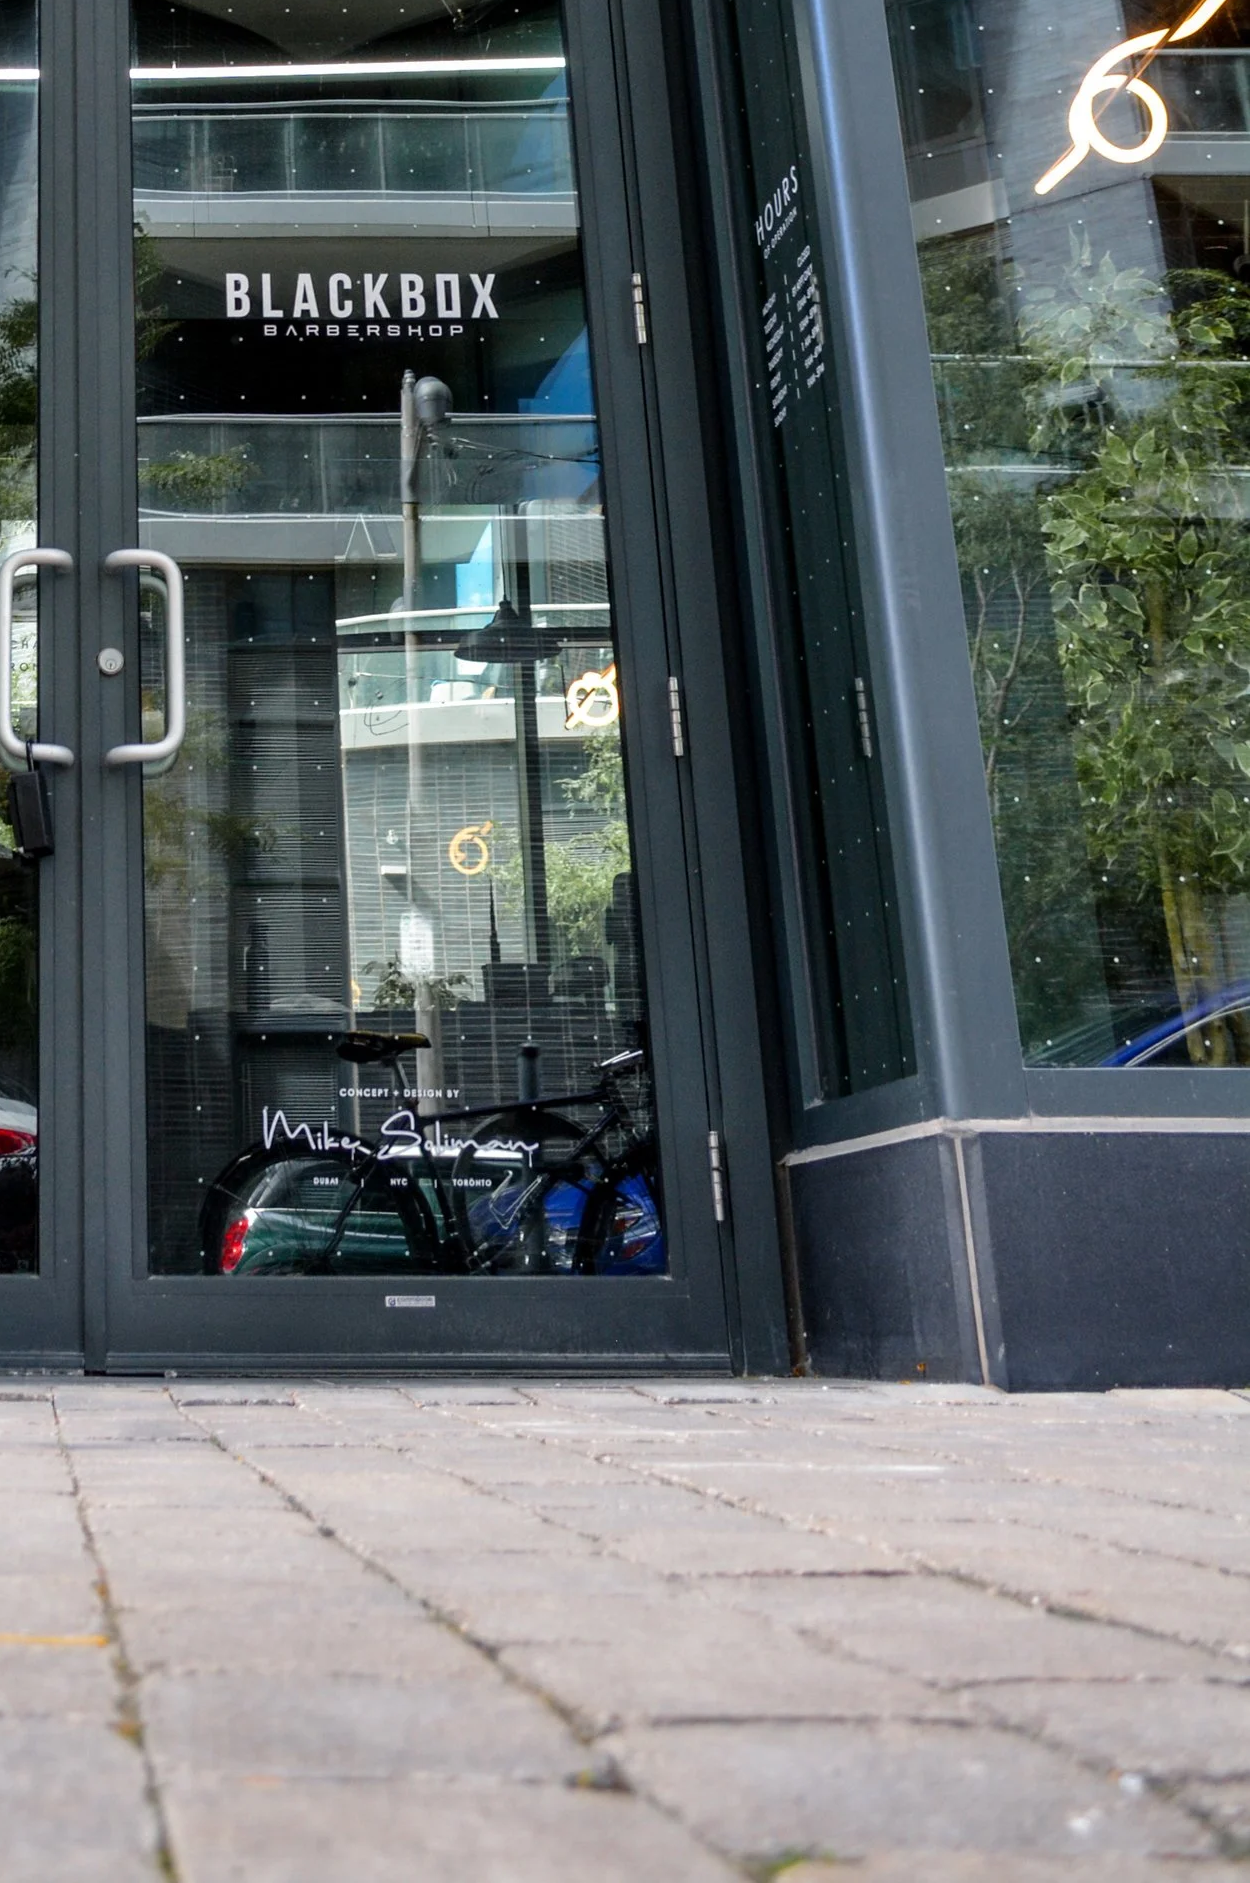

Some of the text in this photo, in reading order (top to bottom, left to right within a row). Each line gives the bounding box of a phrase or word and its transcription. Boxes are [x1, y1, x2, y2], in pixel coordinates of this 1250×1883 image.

[755, 165, 799, 246] HOURS
[225, 272, 499, 319] BLACKBOX
[263, 324, 464, 337] BARBERSHOP
[338, 1088, 389, 1098] CONCEPT
[403, 1088, 443, 1098] DESIGN
[446, 1089, 460, 1098] BY
[262, 1105, 362, 1153] Mike
[389, 1177, 408, 1187] NYC
[452, 1177, 493, 1187] TORONTO
